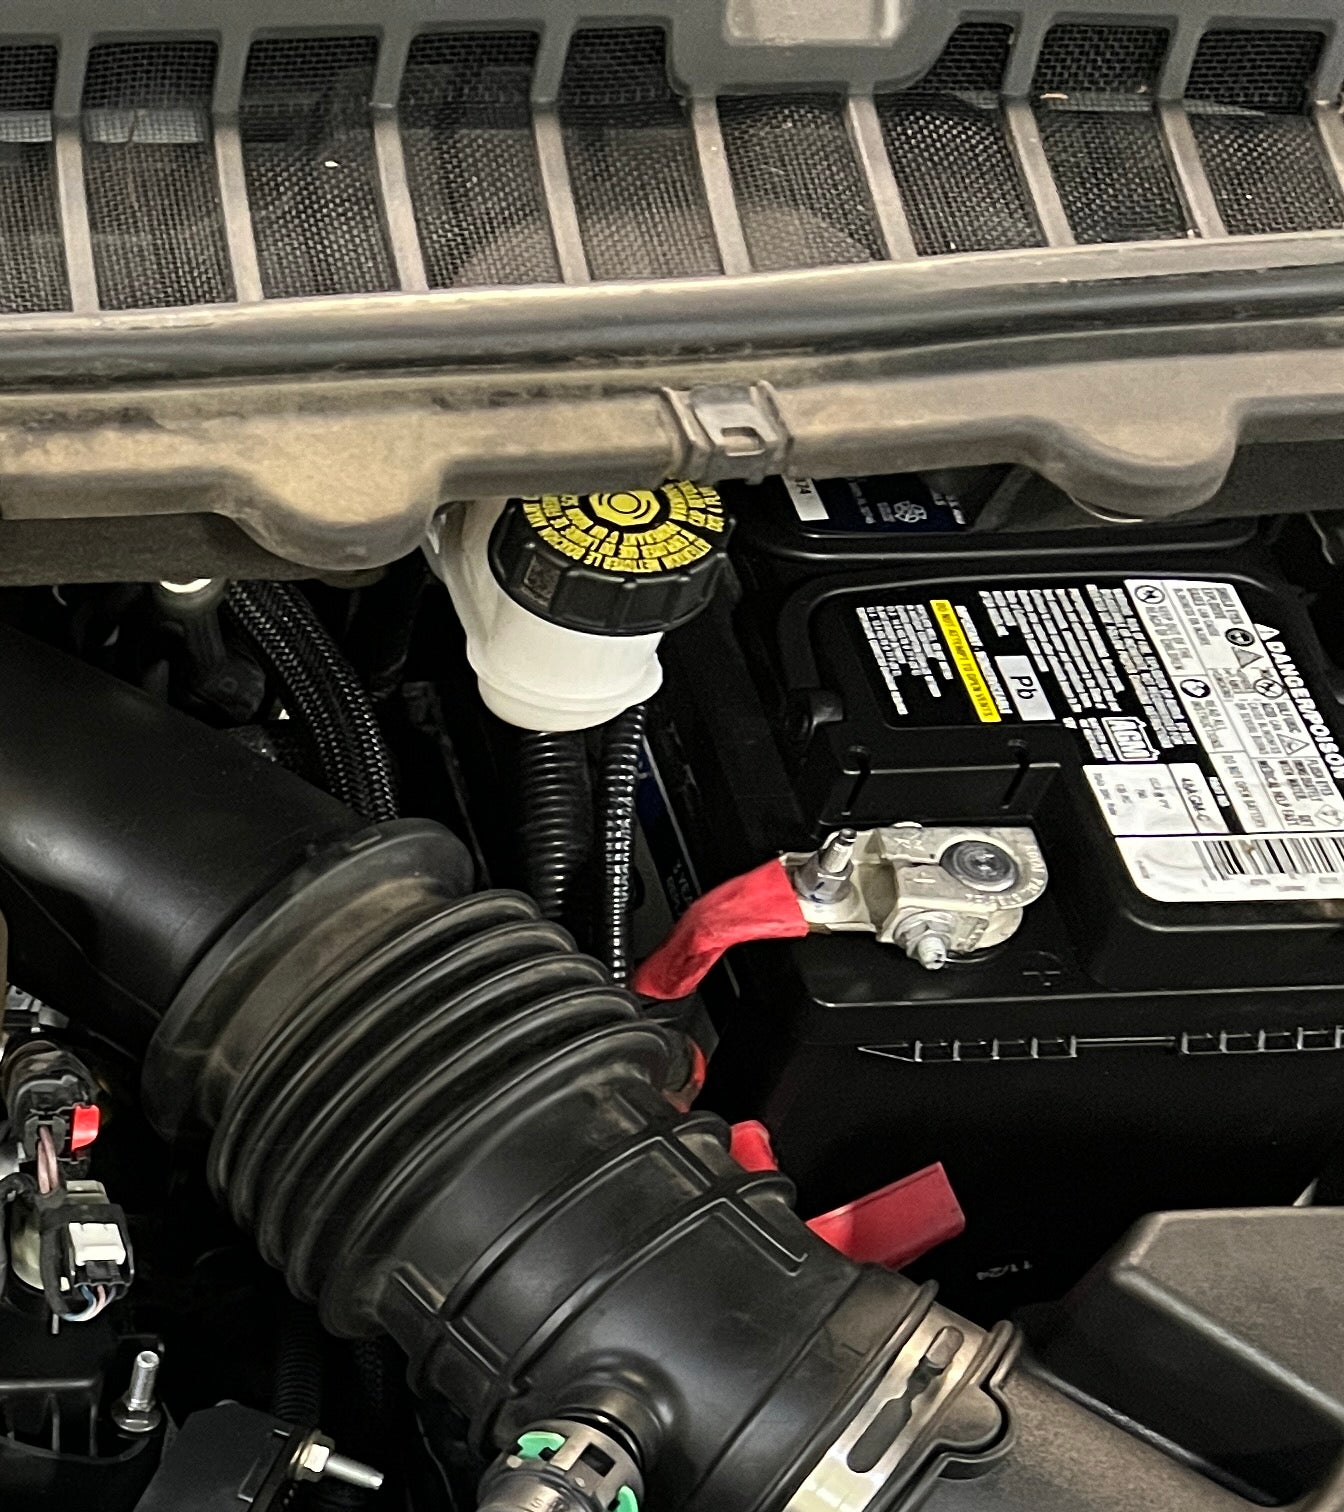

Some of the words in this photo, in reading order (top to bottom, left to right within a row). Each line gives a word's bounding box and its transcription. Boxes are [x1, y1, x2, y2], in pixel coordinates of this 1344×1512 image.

[1013, 674, 1036, 701] Pb
[1265, 640, 1344, 779] DANGER/POISON
[1109, 718, 1150, 760] AGM
